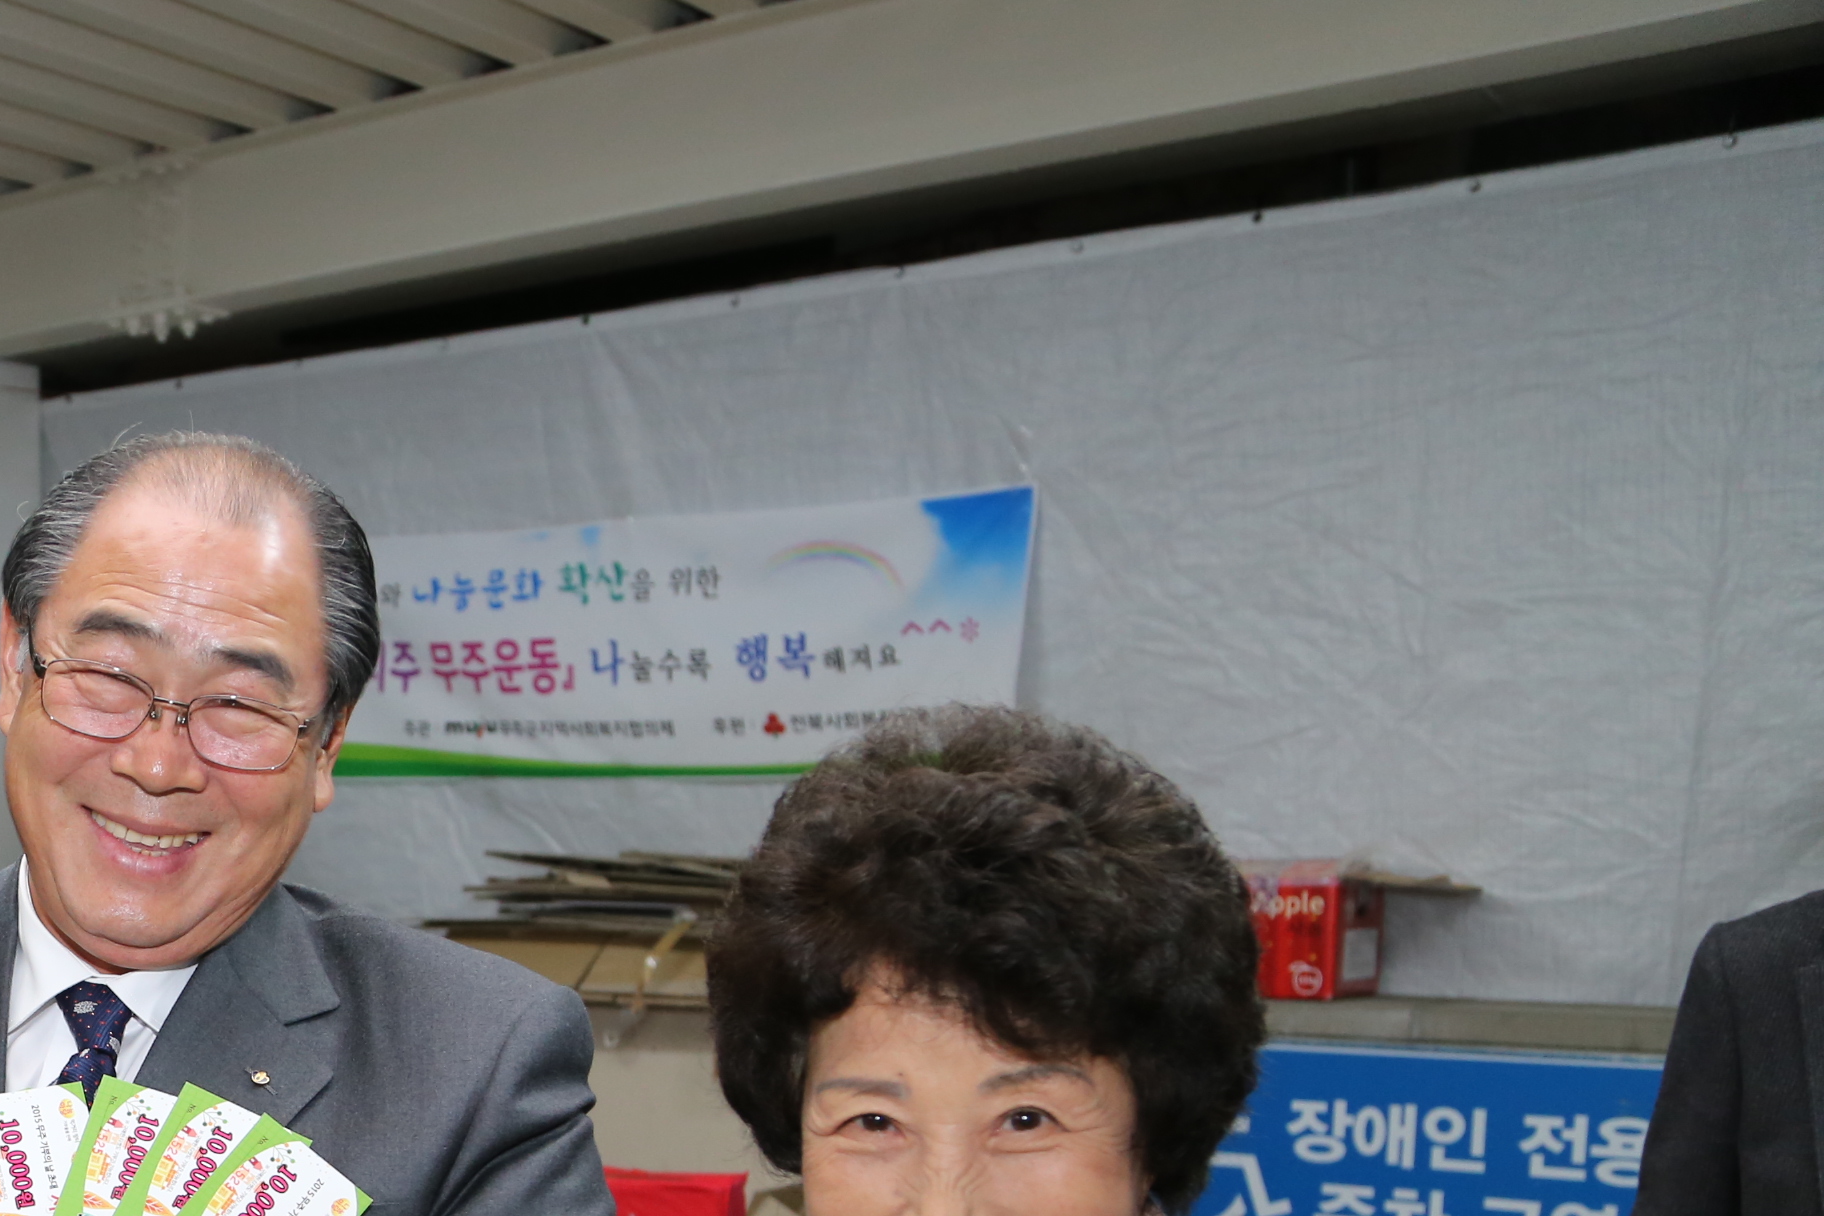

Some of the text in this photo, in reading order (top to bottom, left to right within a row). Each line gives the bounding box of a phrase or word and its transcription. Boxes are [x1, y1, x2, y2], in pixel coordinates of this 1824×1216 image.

[412, 567, 544, 612] 나눔문화
[558, 561, 655, 605] 확산을
[669, 565, 722, 600] 위한
[30, 1104, 42, 1124] 2015
[186, 1102, 196, 1115] No.
[34, 1124, 45, 1140] 무주
[92, 1095, 117, 1156] No. 1525
[38, 1140, 51, 1164] 기부의
[1286, 1099, 1650, 1188] 장애인 전용
[43, 1164, 54, 1173] 날
[223, 1163, 250, 1192] 1523
[46, 1173, 58, 1189] 초대
[306, 1177, 324, 1197] 2015
[294, 1194, 310, 1211] 무주
